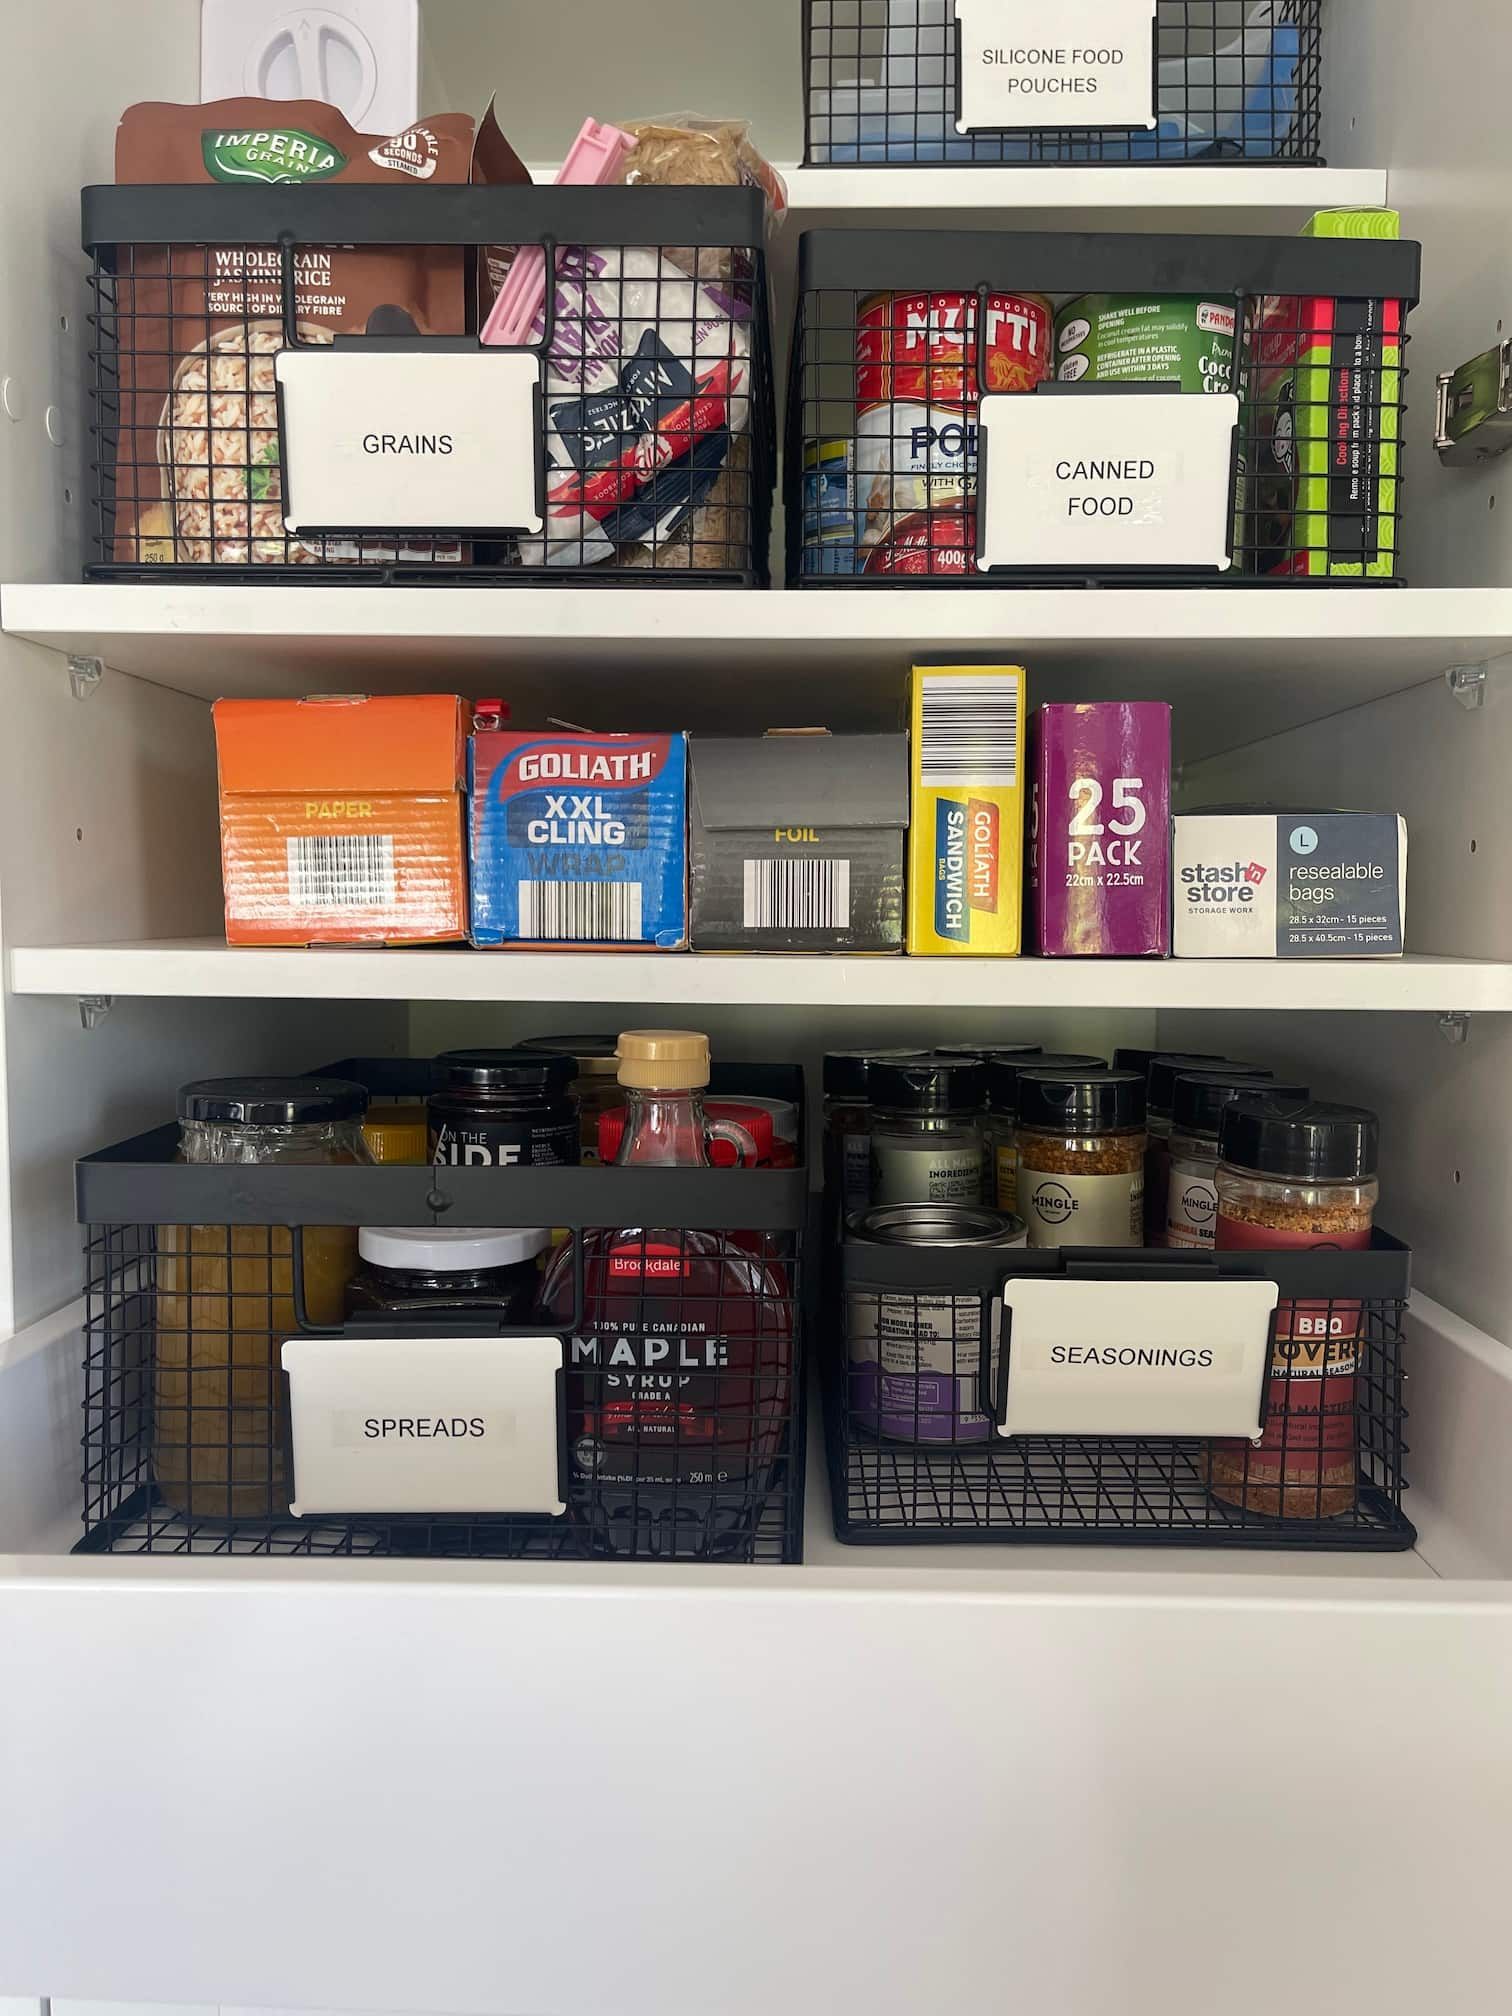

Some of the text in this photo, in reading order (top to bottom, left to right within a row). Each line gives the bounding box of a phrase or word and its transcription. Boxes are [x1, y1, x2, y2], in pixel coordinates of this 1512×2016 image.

[982, 49, 1124, 64] SILICONE FOOD
[1008, 78, 1098, 93] POUCHES
[383, 148, 423, 164] SECONDS
[294, 270, 331, 286] RICE
[204, 292, 230, 302] ERY
[262, 294, 272, 302] IN
[274, 294, 346, 305] WOLEGRAIN
[906, 299, 946, 312] SOO
[208, 303, 249, 313] SOURC
[252, 304, 266, 314] OF
[313, 306, 343, 316] FIBRE
[1118, 308, 1135, 317] WELL
[1135, 305, 1161, 315] BEFORE
[906, 307, 1037, 357] MUTTI
[1151, 345, 1178, 354] PLASTIC
[1097, 354, 1182, 370] CONTAINER AFTER OPENING
[1121, 364, 1146, 375] WITHIN
[1152, 362, 1169, 371] DAYS
[1353, 357, 1362, 373] ito
[1352, 374, 1363, 395] place
[1352, 410, 1362, 429] pack
[362, 434, 453, 454] GRAINS
[1351, 430, 1361, 449] frm
[911, 463, 942, 471] FINLY
[1352, 450, 1362, 468] soup
[1055, 460, 1154, 480] CANNED
[922, 478, 954, 487] WITH
[1350, 470, 1360, 500] Remoe
[1068, 497, 1134, 516] FOOD
[519, 752, 652, 782] GOLIATH
[305, 801, 373, 820] PAPER
[545, 795, 612, 820] XXL
[1068, 778, 1146, 837] 25
[527, 820, 626, 846] CLING
[775, 828, 820, 843] FOIL
[1300, 834, 1310, 848] L
[1068, 840, 1142, 867] PACK
[527, 852, 627, 877] WRAP
[945, 810, 964, 930] SANDWICH
[1181, 862, 1248, 883] stash
[1289, 863, 1384, 880] resealable
[1066, 873, 1144, 887] 22cm x 22.5cm
[1187, 883, 1255, 903] store
[1289, 884, 1335, 905] bags
[1289, 915, 1308, 924] 28.5
[1315, 915, 1340, 924] 32cm
[1347, 915, 1357, 924] 15
[1359, 915, 1388, 926] pieces
[1289, 934, 1307, 943] 28.5
[1315, 934, 1347, 942] 40.5cm
[1353, 933, 1364, 942] 15
[1365, 933, 1393, 944] pieces
[460, 1132, 488, 1145] THE
[1031, 1194, 1079, 1210] MINGLE
[1181, 1196, 1218, 1212] MINGLE
[622, 1322, 648, 1332] PUE
[1299, 1317, 1343, 1334] BBQ
[571, 1335, 728, 1367] MAPLE
[1050, 1346, 1214, 1367] SEASONINGS
[607, 1373, 691, 1388] SYRUP
[364, 1417, 485, 1438] SPREADS
[689, 1472, 704, 1483] 250
